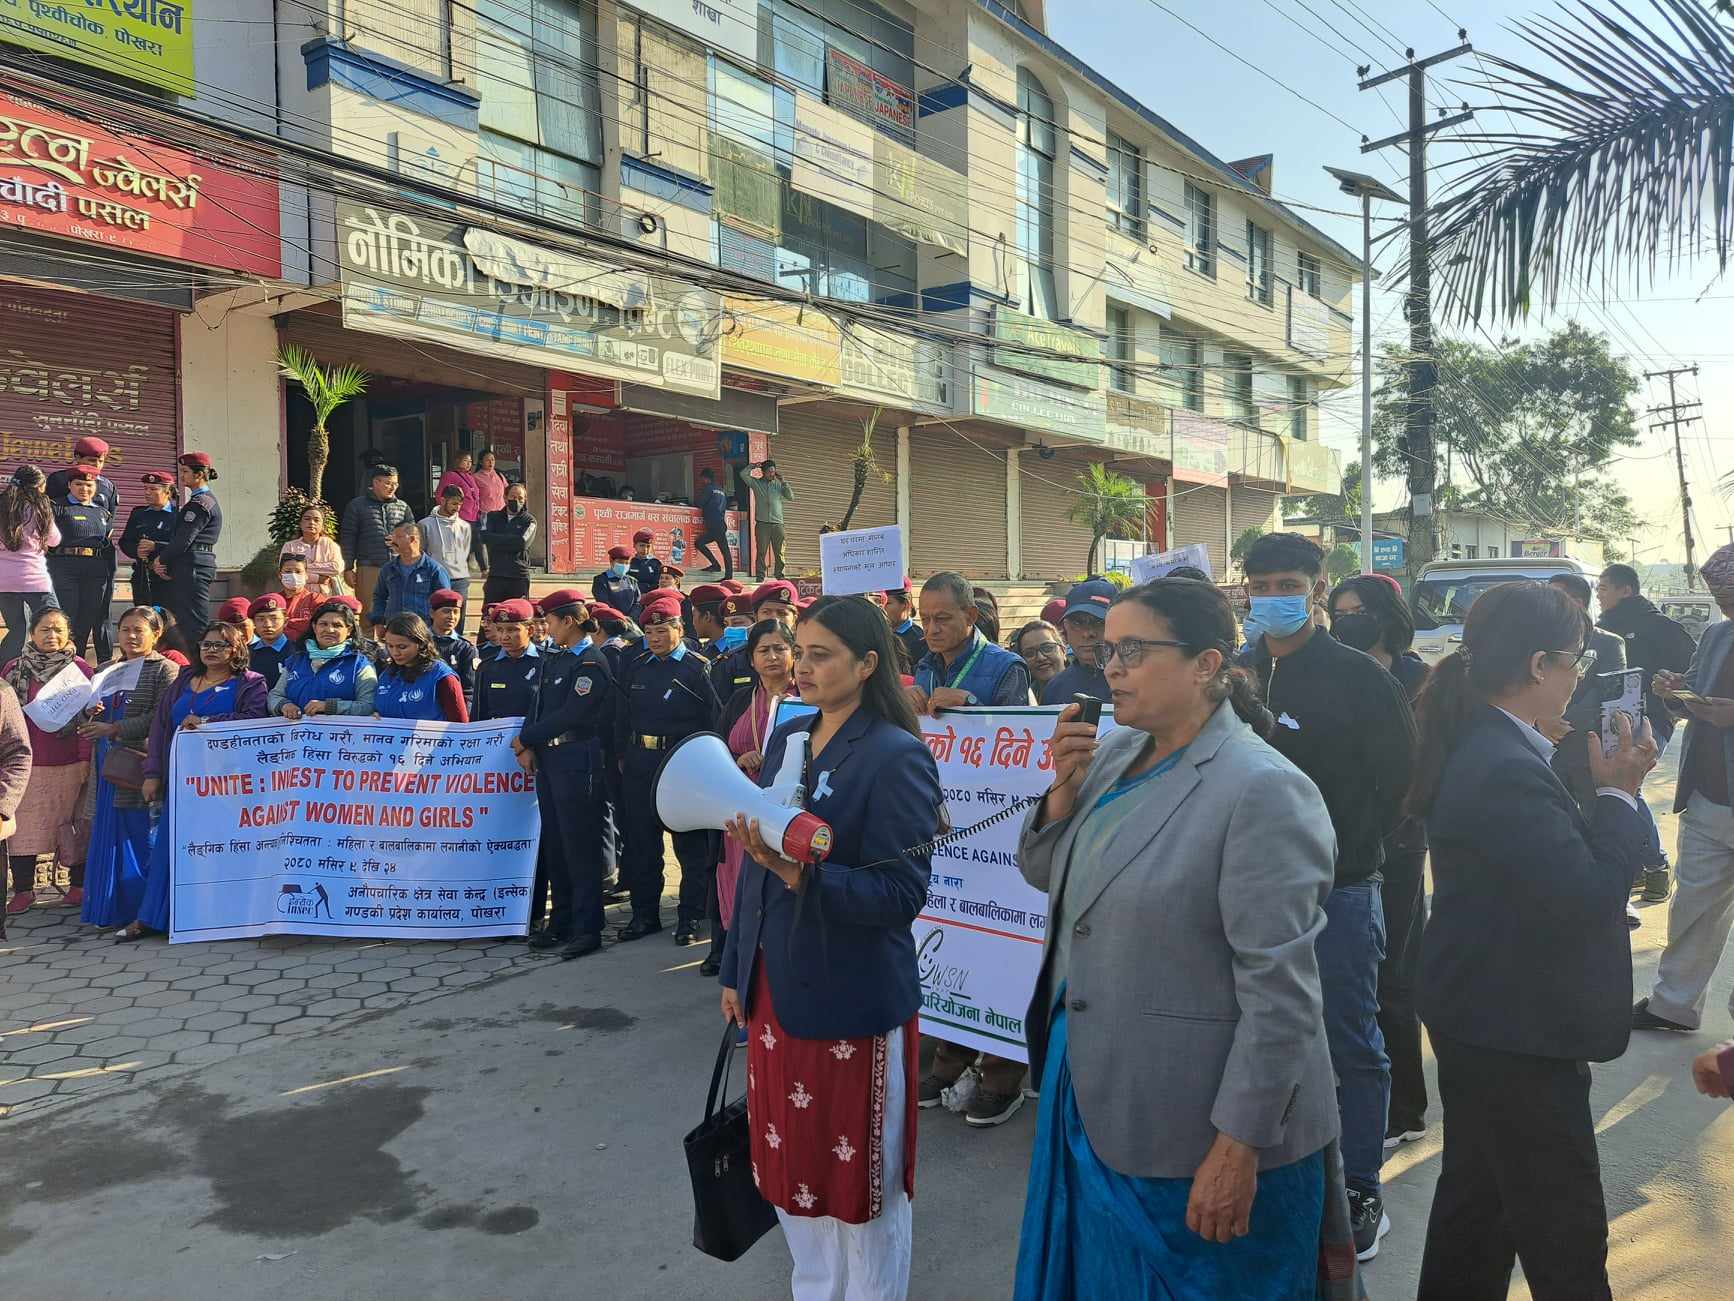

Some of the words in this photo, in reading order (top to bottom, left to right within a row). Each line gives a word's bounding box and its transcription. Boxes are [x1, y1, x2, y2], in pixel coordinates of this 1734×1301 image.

[92, 155, 202, 209] ज्वेलर्स
[76, 196, 151, 230] पसल
[551, 440, 568, 455] तथा
[207, 731, 285, 750] दण्डहीनताको
[363, 733, 394, 745] मानव
[400, 733, 452, 748] गरिमाको
[459, 738, 481, 751] रक्षा
[959, 736, 986, 769] १६
[989, 726, 1035, 769] दिने
[303, 746, 331, 762] हिंसा
[389, 753, 405, 767] १६
[440, 753, 484, 767] अभियान
[333, 769, 355, 790] TO
[360, 770, 442, 794] PREVENT
[445, 769, 536, 794] VIOLENCE
[943, 787, 971, 803] २०८०
[976, 787, 1007, 807] मसिर
[306, 801, 374, 825] WOMEN
[378, 805, 414, 828] AND
[419, 806, 475, 829] GIRLS
[337, 834, 365, 849] महिला
[369, 839, 375, 850] र
[284, 856, 312, 870] २०८०
[318, 855, 346, 872] मसिर
[361, 858, 380, 872] देखि
[384, 862, 397, 874] २४
[971, 848, 1020, 868] AGAINS
[347, 884, 409, 901] अनौपचारिक
[438, 885, 458, 900] सेवा
[464, 886, 486, 902] केन्द्र
[345, 903, 383, 918] गण्डकी
[389, 904, 411, 921] प्रदेश
[471, 904, 506, 919] पोखरा
[926, 889, 947, 910] हिला
[950, 897, 958, 913] र
[959, 899, 1027, 926] बालबालिकामा
[921, 991, 981, 1023] परियोजना
[984, 1006, 1023, 1035] नेपाल
